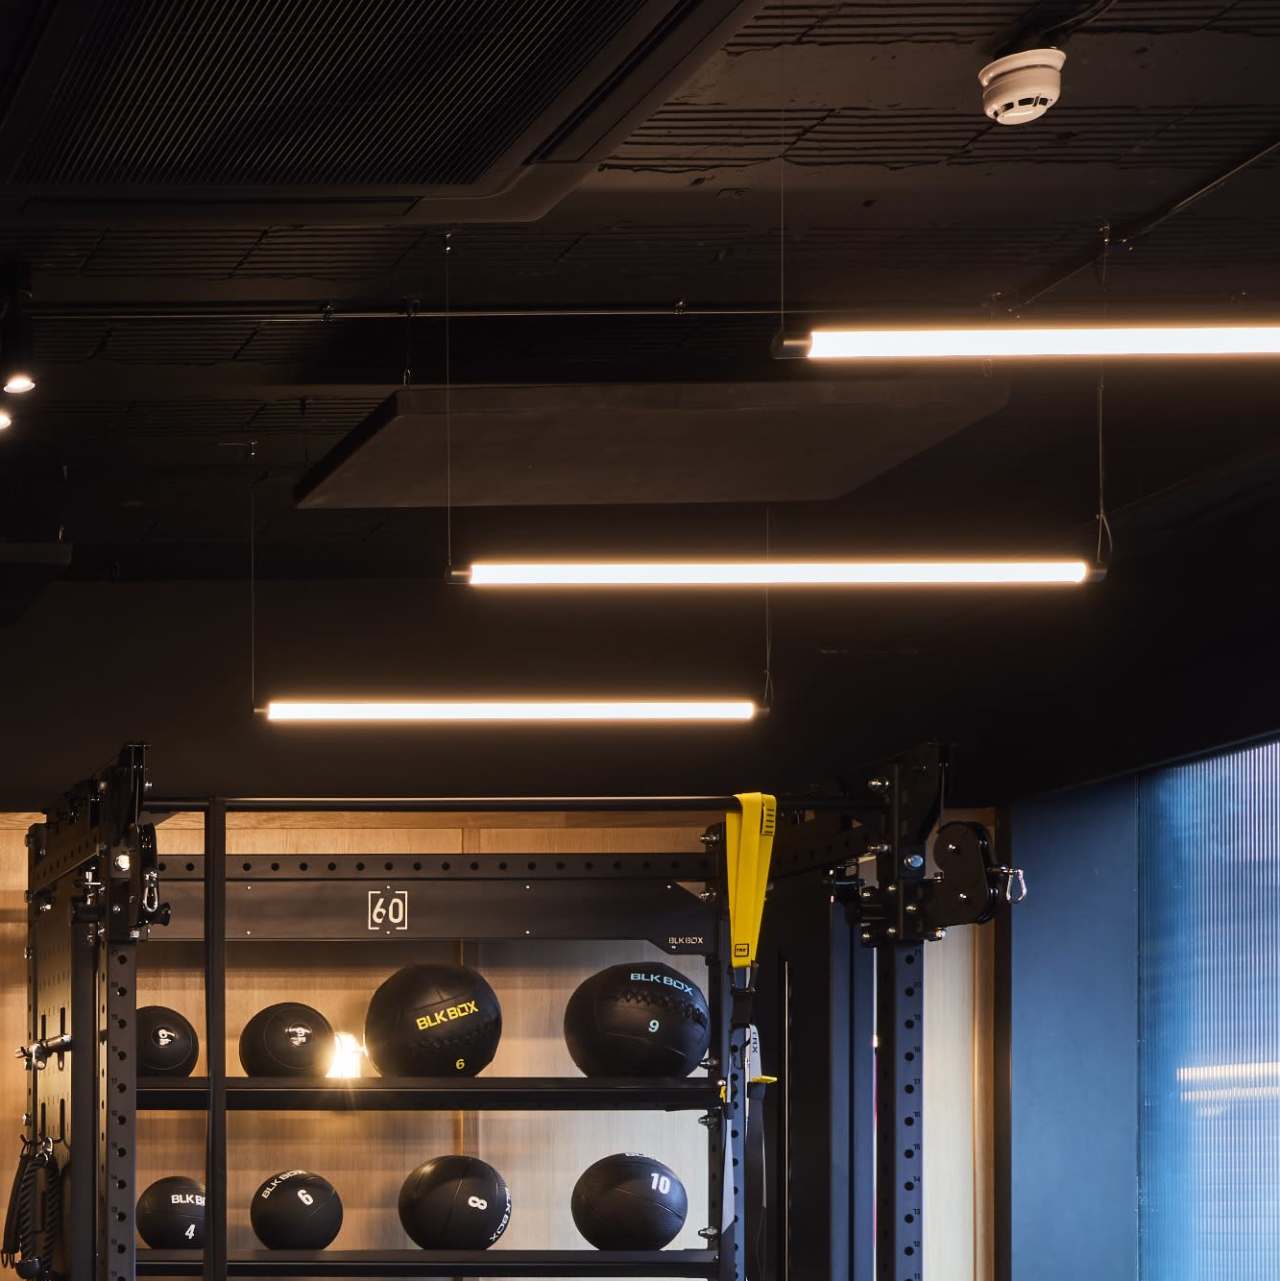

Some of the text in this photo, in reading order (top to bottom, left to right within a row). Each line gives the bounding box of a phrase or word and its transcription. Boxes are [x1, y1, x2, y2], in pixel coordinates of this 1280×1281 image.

[668, 936, 704, 945] BLK BOX
[630, 972, 694, 996] BLK BOX
[415, 1000, 479, 1031] BLK BOX
[648, 1019, 660, 1033] 9
[455, 1058, 466, 1070] 6
[262, 1179, 282, 1199] BLK
[651, 1172, 671, 1195] 10
[171, 1193, 194, 1204] BLK
[297, 1189, 314, 1206] 6
[468, 1196, 488, 1211] 8
[184, 1223, 196, 1240] 4
